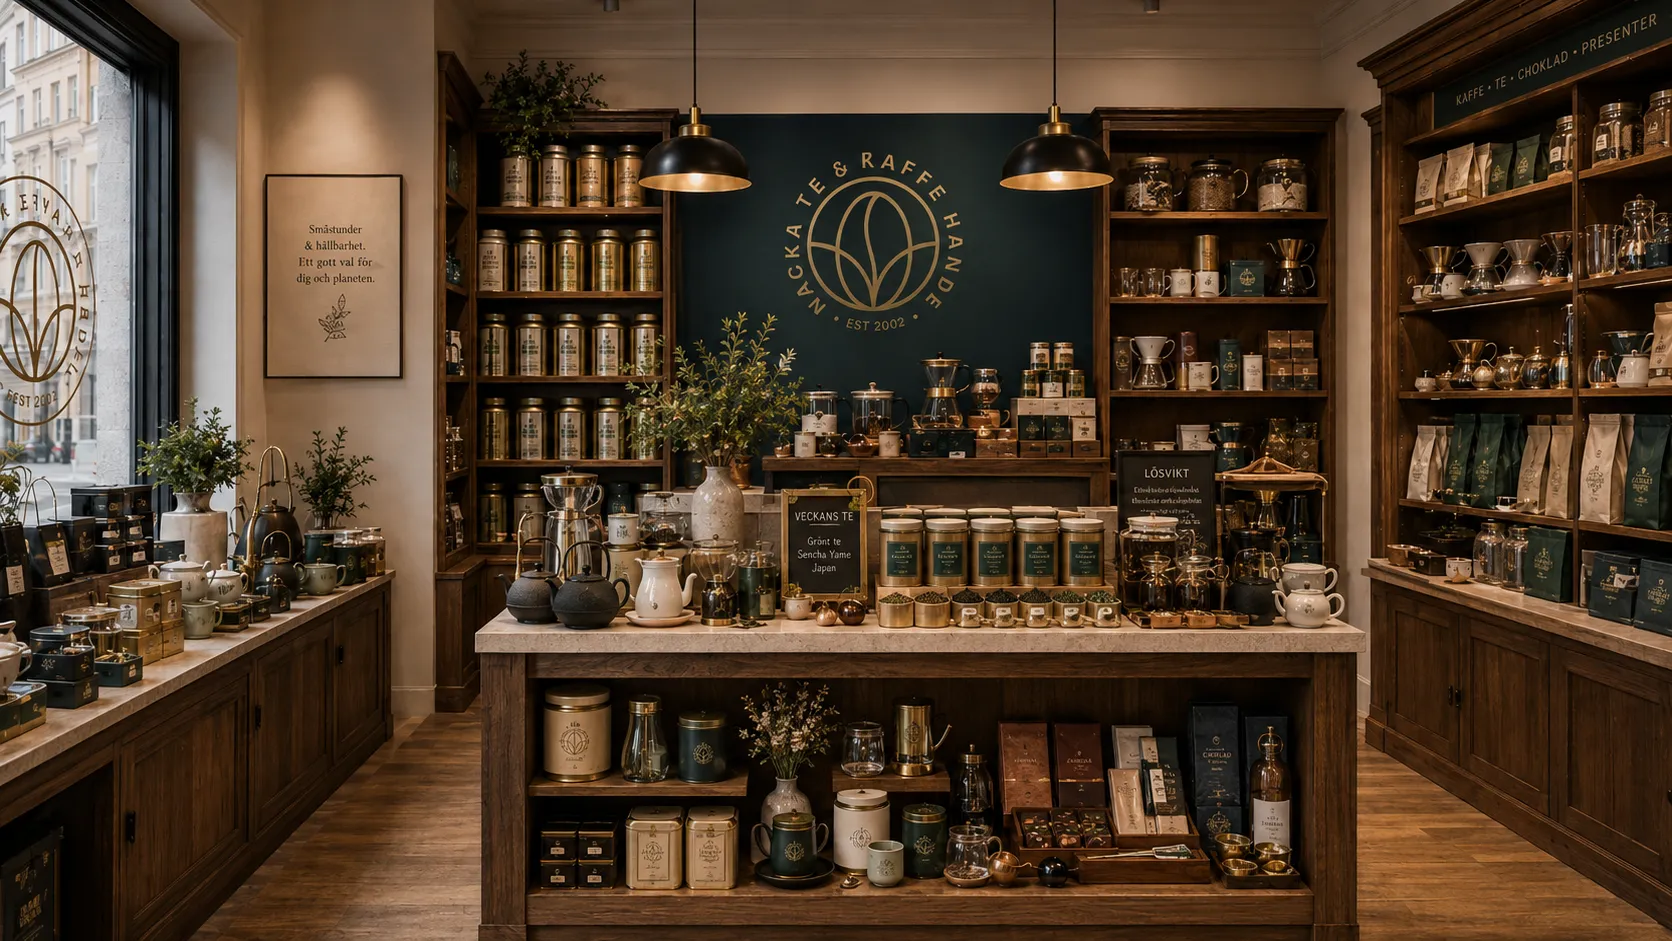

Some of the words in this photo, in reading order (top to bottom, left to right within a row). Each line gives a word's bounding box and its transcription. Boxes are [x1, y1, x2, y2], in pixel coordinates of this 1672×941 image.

[1456, 85, 1485, 106] KAFFE
[1494, 75, 1507, 90] TE
[1517, 50, 1569, 81] CHOKLAD
[1581, 13, 1658, 55] PRESENTER
[832, 160, 848, 178] &
[795, 177, 826, 208] TE
[308, 224, 363, 235] Småstunder
[304, 240, 313, 251] &
[316, 240, 366, 251] hållbarhet.
[298, 256, 314, 267] Ett
[316, 258, 337, 270] gott
[339, 256, 354, 267] val
[357, 256, 373, 267] för
[924, 212, 964, 309] HANDE
[784, 223, 827, 316] NACKA
[296, 273, 311, 286] dig
[313, 272, 330, 283] och
[333, 272, 376, 286] planeten.
[845, 317, 870, 331] EST
[874, 316, 906, 332] 2002
[794, 511, 839, 521] VECKANS
[841, 511, 854, 521] TE
[807, 536, 830, 546] Grönt
[833, 537, 841, 546] te
[797, 549, 827, 559] Sencha
[829, 550, 852, 560] Yame
